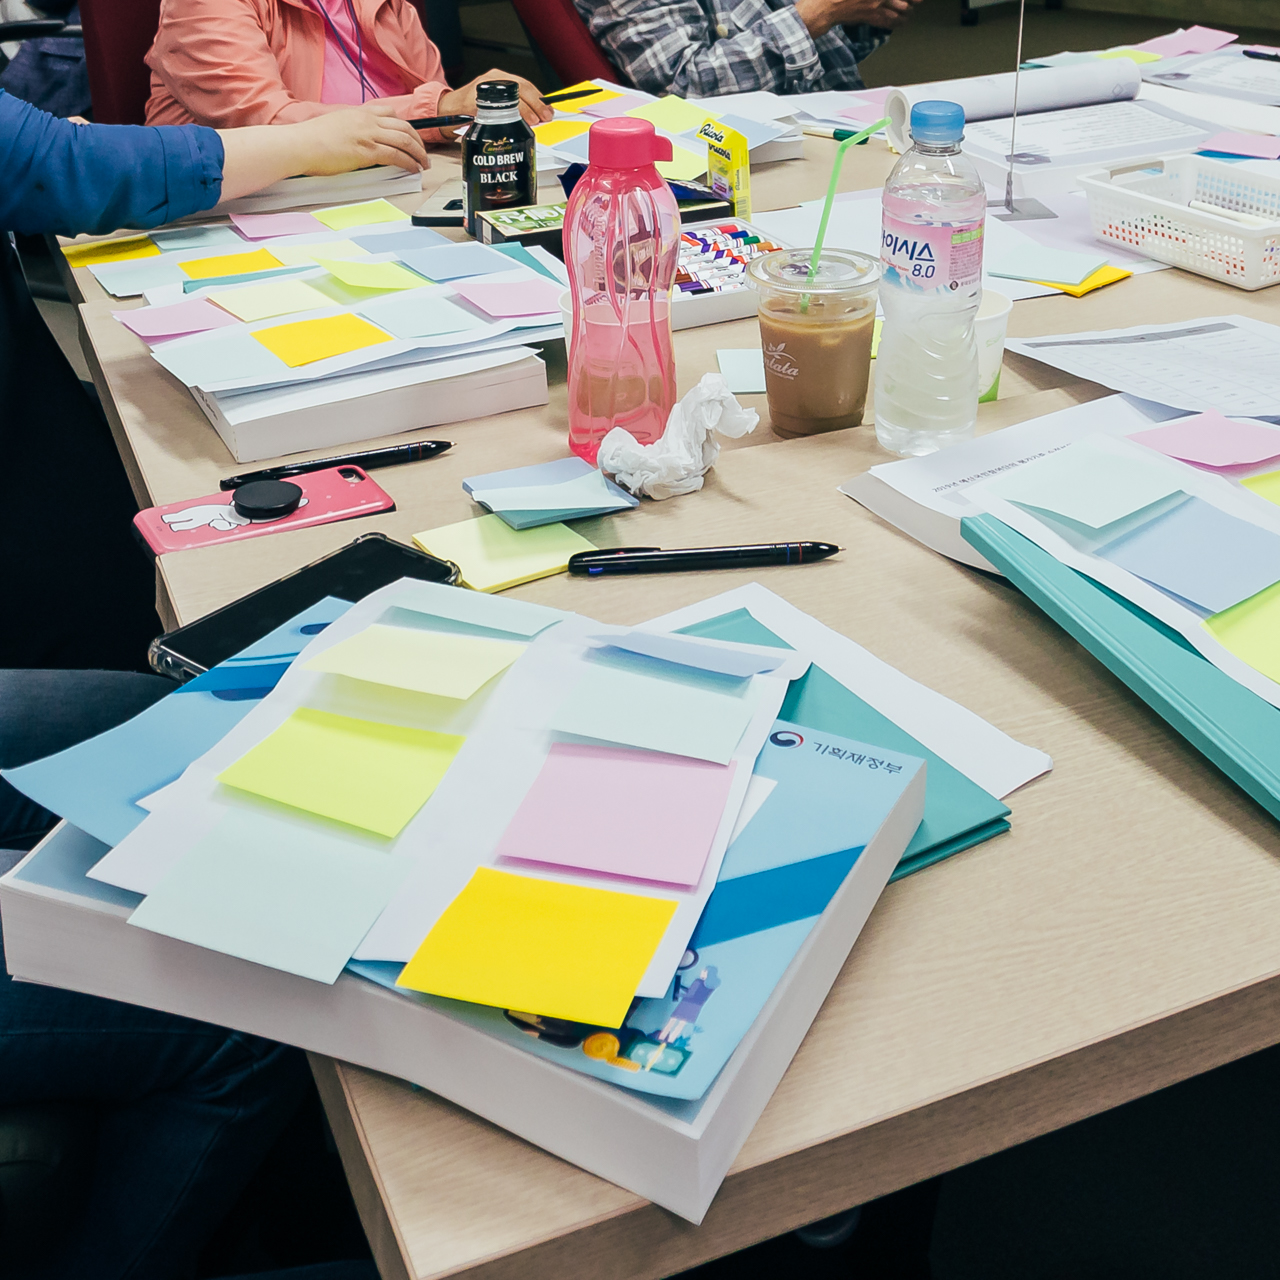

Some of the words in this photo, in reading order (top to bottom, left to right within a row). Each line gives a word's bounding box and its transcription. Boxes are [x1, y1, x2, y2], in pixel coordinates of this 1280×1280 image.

[699, 123, 725, 143] Ricola
[473, 155, 496, 166] COLD
[496, 151, 524, 166] BREW
[480, 171, 518, 184] BLACK
[911, 263, 936, 279] 8.0
[813, 741, 903, 774] 기획재정부
